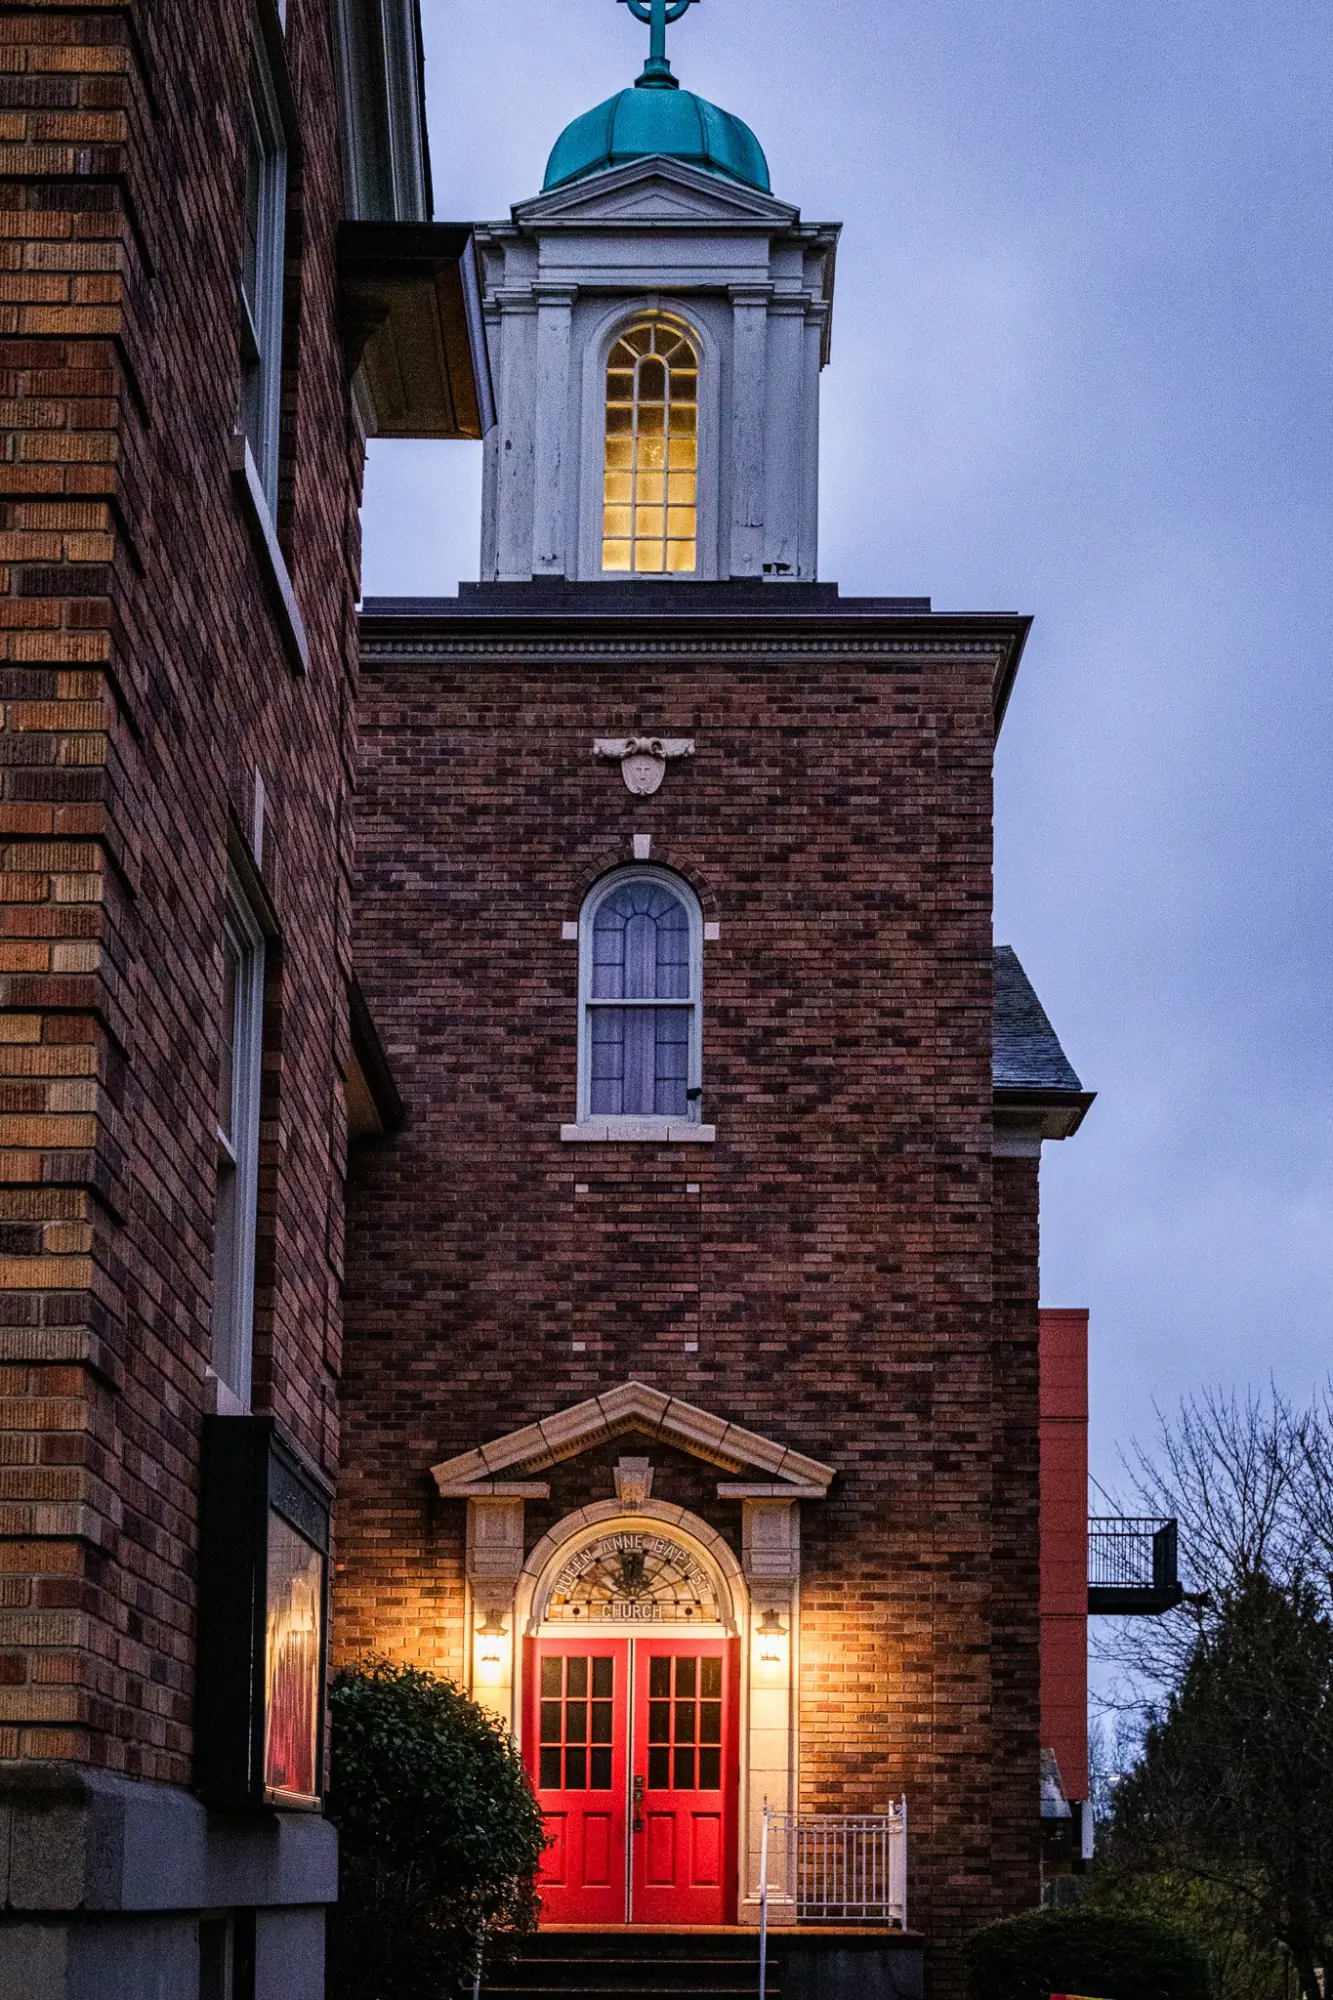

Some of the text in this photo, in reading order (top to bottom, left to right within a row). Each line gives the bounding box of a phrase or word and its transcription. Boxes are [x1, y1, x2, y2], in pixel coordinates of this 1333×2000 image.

[554, 1534, 712, 1596] QUEEN ANNE BAPTIST
[602, 1604, 662, 1619] CHURCH
